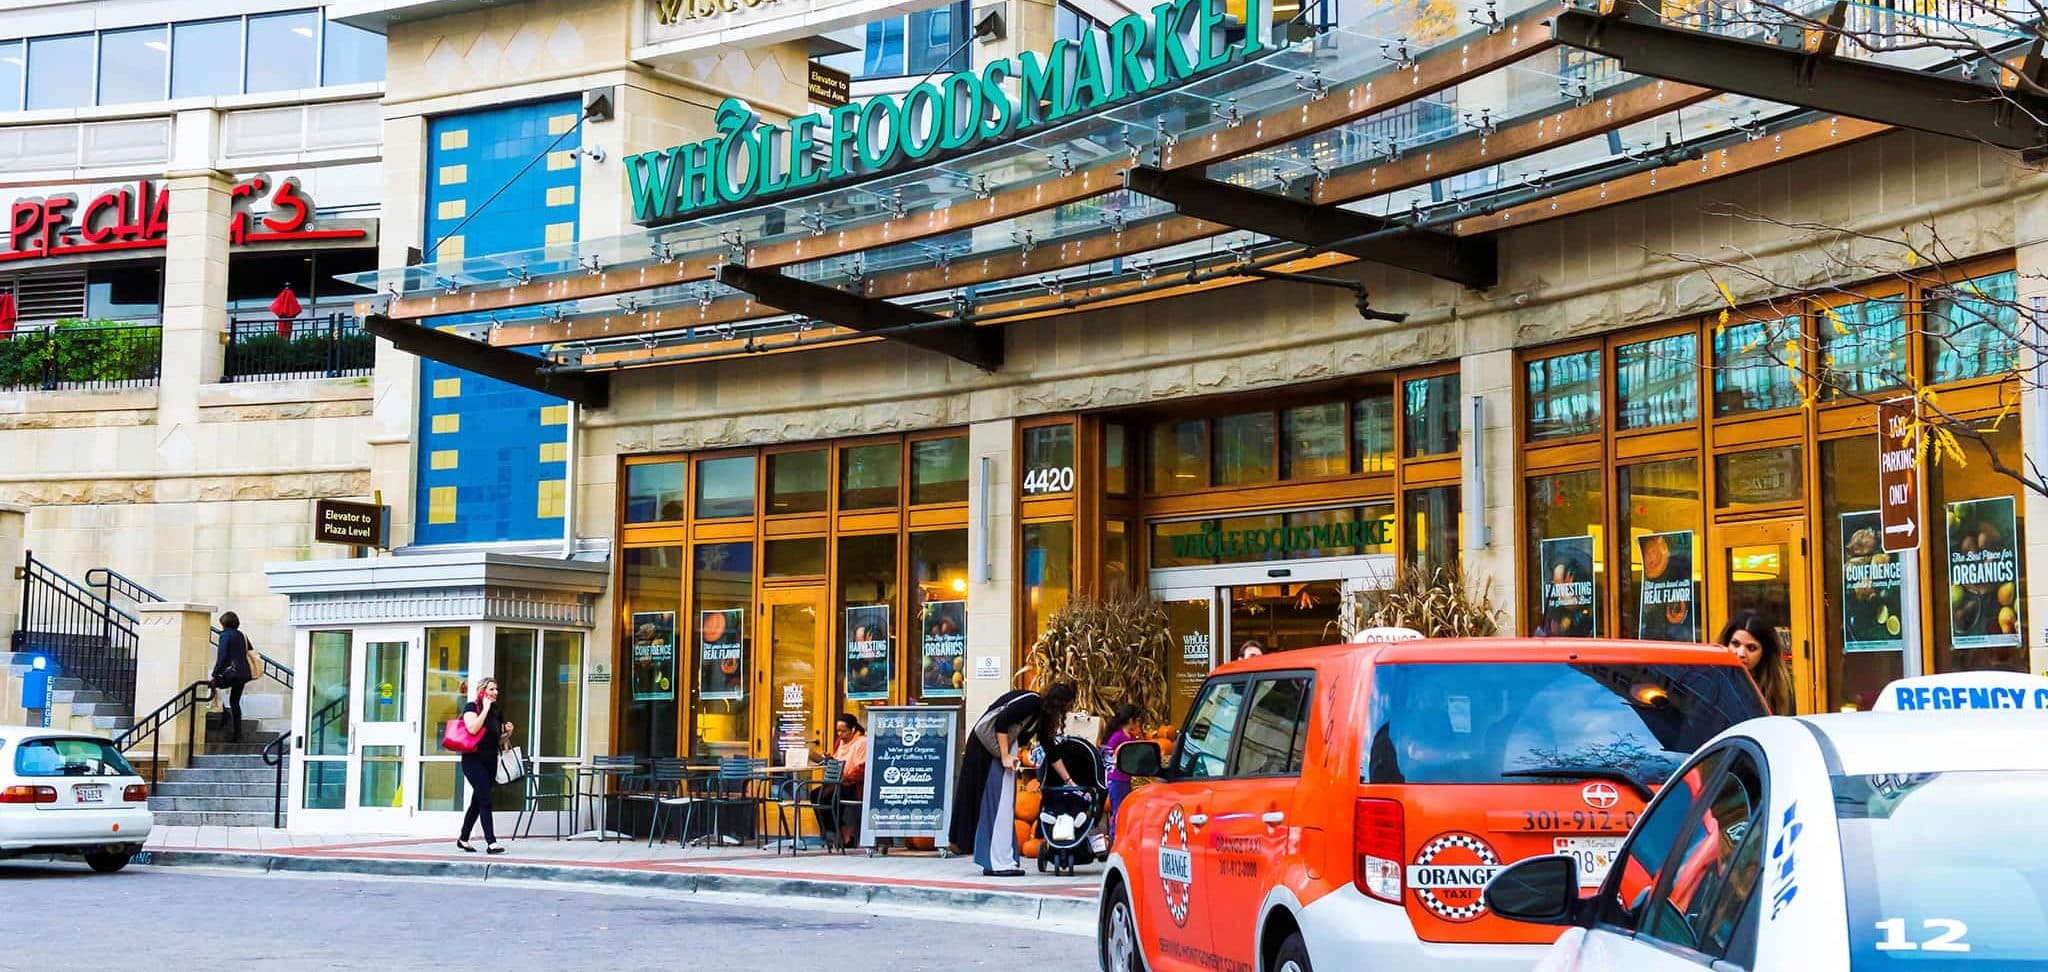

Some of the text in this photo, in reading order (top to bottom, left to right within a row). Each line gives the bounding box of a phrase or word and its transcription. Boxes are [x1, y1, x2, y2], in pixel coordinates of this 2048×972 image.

[811, 71, 847, 90] Elevator to
[808, 82, 831, 98] Willard
[623, 0, 1264, 220] WHOLE FOODS MARKET
[11, 197, 73, 257] P.F.
[1882, 447, 1915, 473] PARKING
[1023, 466, 1074, 493] 4420
[1889, 483, 1908, 506] ONLY
[325, 509, 371, 523] Elevator to
[324, 523, 371, 537] Plaza Level
[1171, 520, 1240, 558] WHOLE
[1241, 524, 1311, 555] FOODS
[1952, 552, 1965, 562] The
[2000, 547, 2013, 561] for
[1846, 562, 1901, 582] CONFIDENCE
[1952, 560, 2014, 585] ORGANICS
[1644, 586, 1691, 604] REAL FLAVOR
[848, 639, 887, 652] HARVESTING
[1183, 631, 1208, 645] WHOLE
[634, 644, 673, 656] CONFIDENCE
[703, 648, 740, 660] REAL FLAVOR
[925, 640, 963, 657] ORGANICS
[1184, 644, 1208, 654] FOODS
[1895, 686, 2026, 711] REGENCY
[1162, 852, 1189, 878] ORANGE
[1442, 889, 1472, 899] TAXI
[1875, 917, 1971, 952] 12
